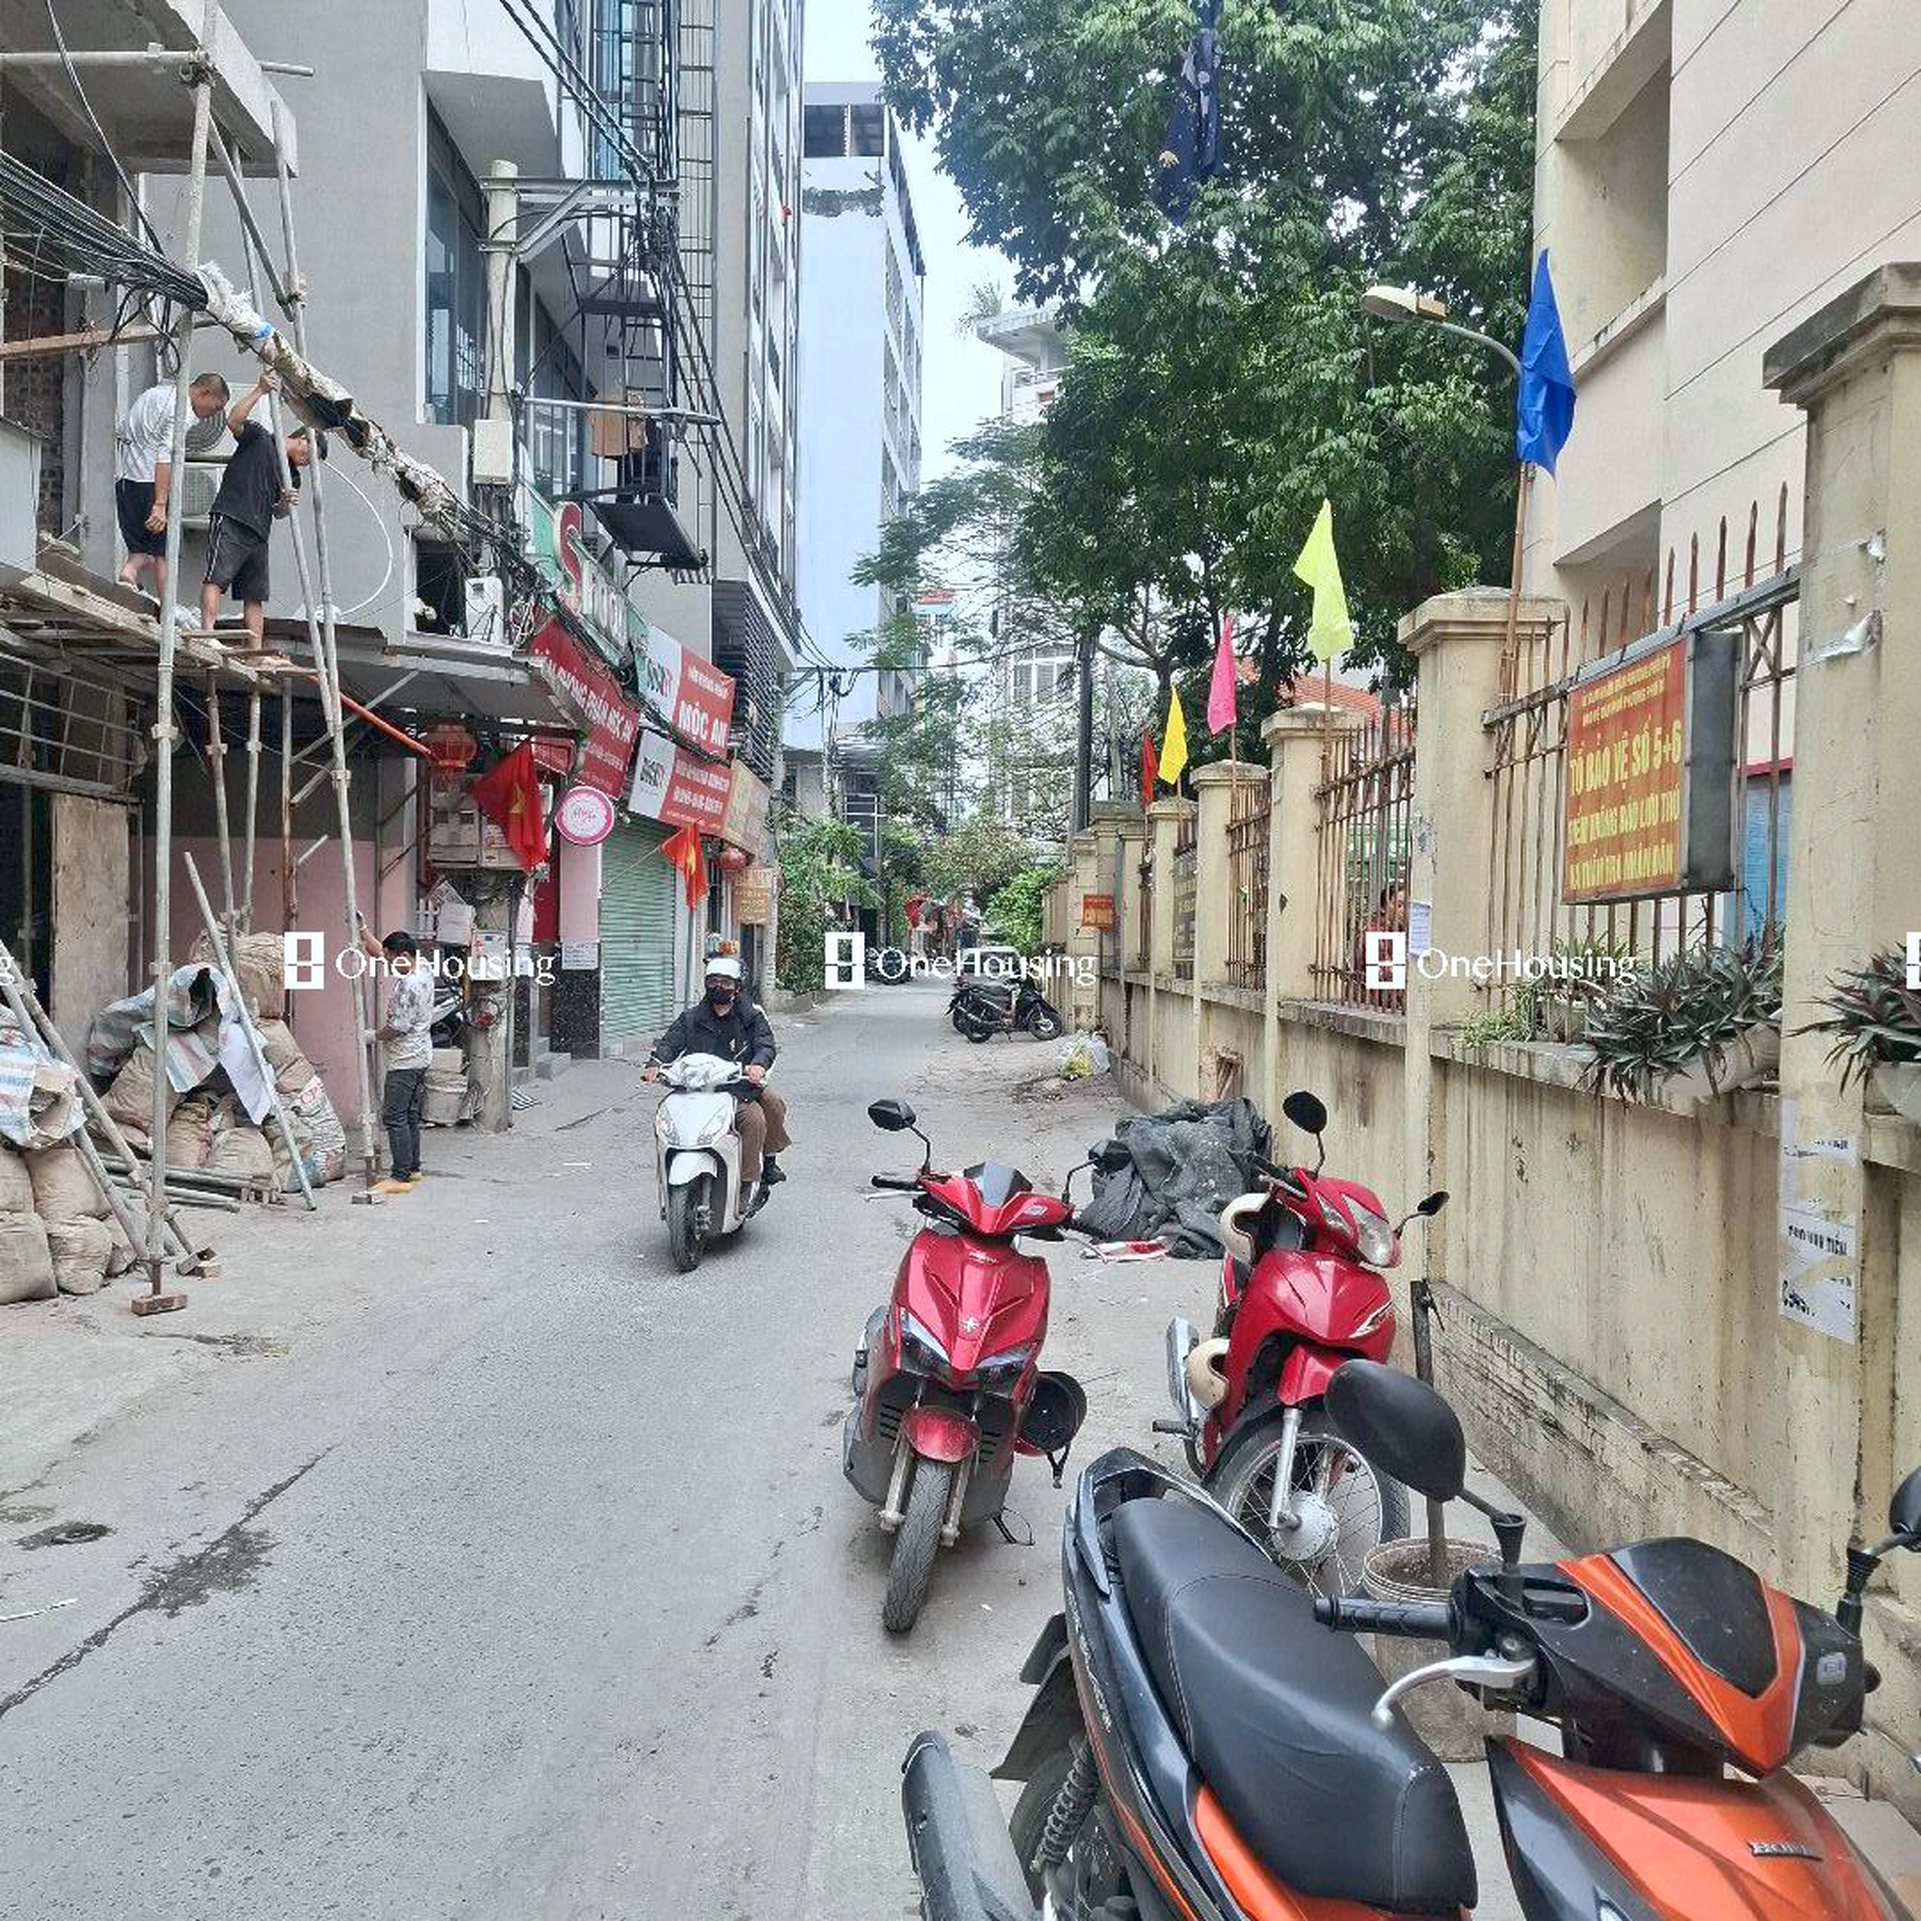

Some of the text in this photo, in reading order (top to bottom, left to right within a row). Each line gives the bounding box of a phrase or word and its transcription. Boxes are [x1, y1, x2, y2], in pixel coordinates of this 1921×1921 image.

[1586, 733, 1610, 792] BẢO
[1614, 731, 1629, 789] VỆ
[1631, 714, 1650, 776] SỐ
[1653, 719, 1682, 769] 5+6
